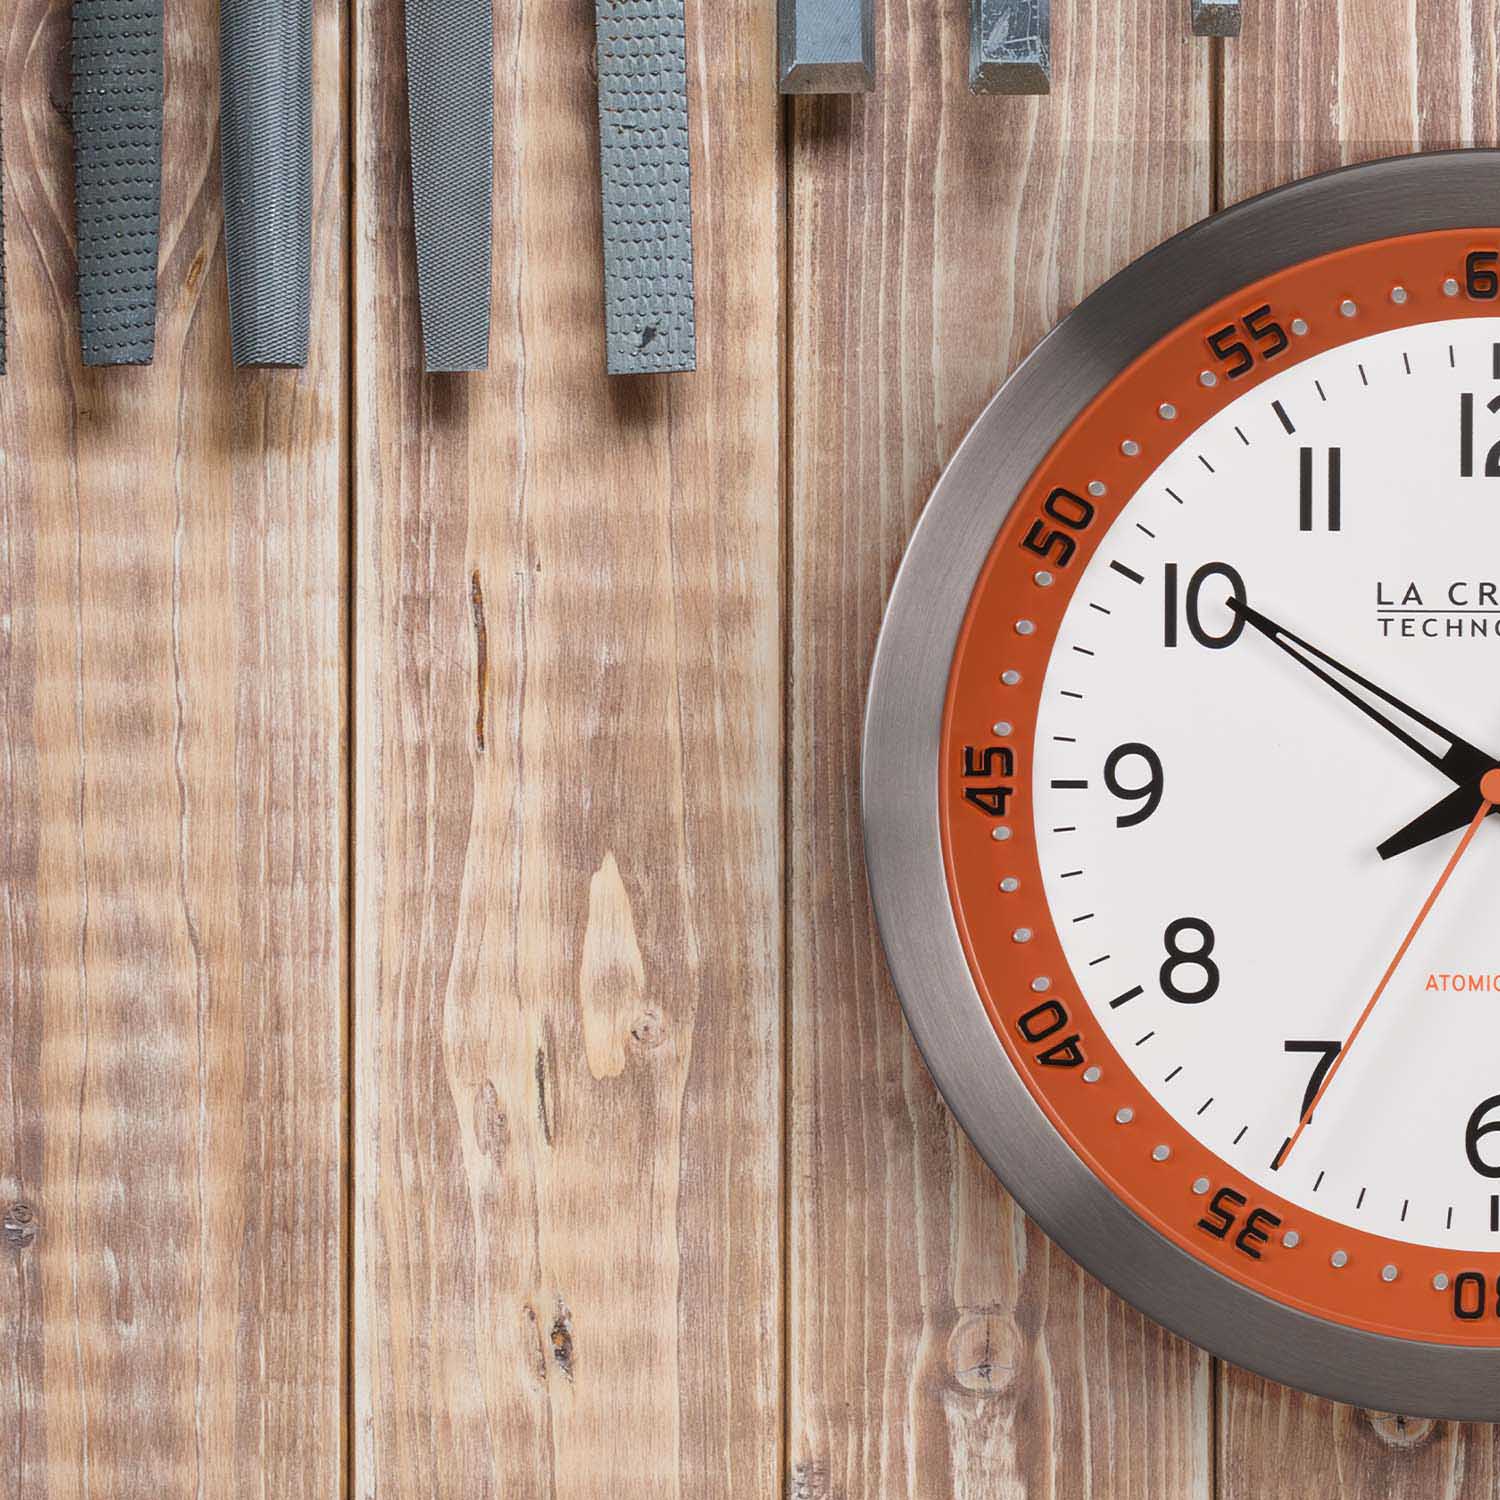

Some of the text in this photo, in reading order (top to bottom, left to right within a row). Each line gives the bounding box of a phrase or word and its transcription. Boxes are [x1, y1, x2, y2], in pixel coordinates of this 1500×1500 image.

[1208, 304, 1289, 379] 55
[1021, 487, 1095, 568] 50
[1299, 446, 1341, 532] 11
[1164, 561, 1248, 650] 10
[1377, 582, 1424, 606] LA
[964, 745, 1014, 817] 45
[1103, 742, 1164, 829] 9
[1159, 916, 1220, 1005] 8
[1017, 999, 1085, 1069] 40
[1284, 1040, 1342, 1125] 7
[1197, 1187, 1282, 1260] 35
